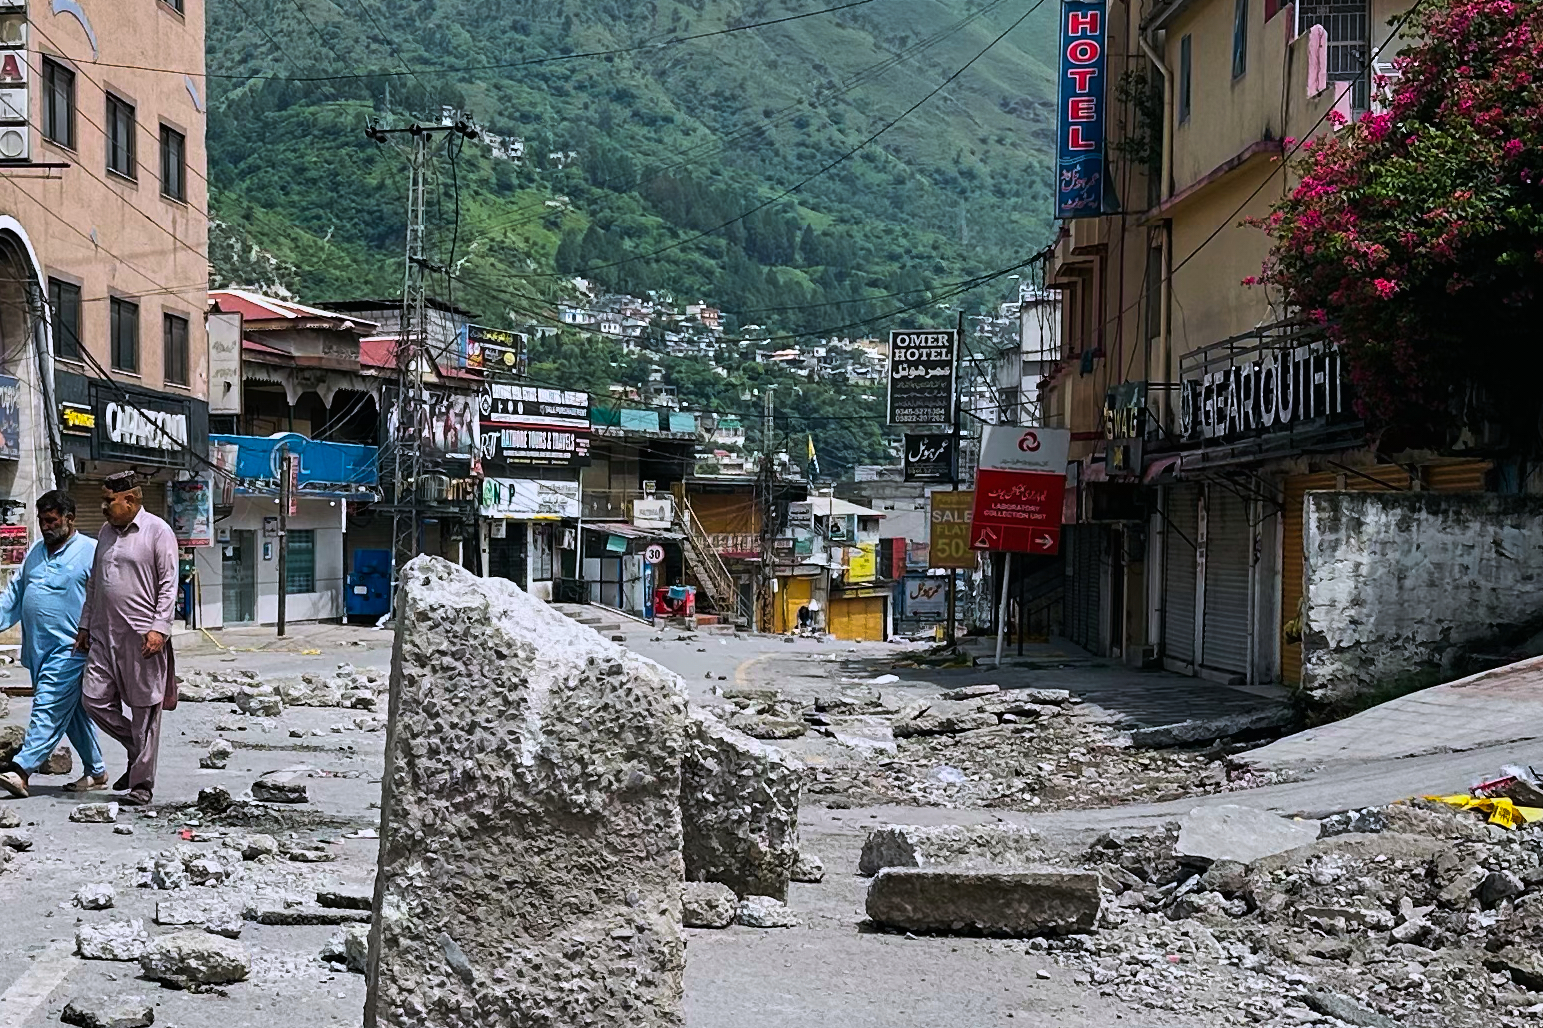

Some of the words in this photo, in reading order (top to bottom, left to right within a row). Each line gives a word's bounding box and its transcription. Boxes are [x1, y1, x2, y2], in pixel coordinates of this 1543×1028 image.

[1066, 10, 1101, 151] HOTEL
[896, 334, 950, 347] OMER
[893, 348, 951, 361] HOTEL
[991, 502, 1041, 512] LABORATORY
[932, 510, 973, 523] SALE
[983, 510, 1029, 519] COLLECTION
[936, 524, 968, 536] FLAT
[648, 549, 661, 560] 30
